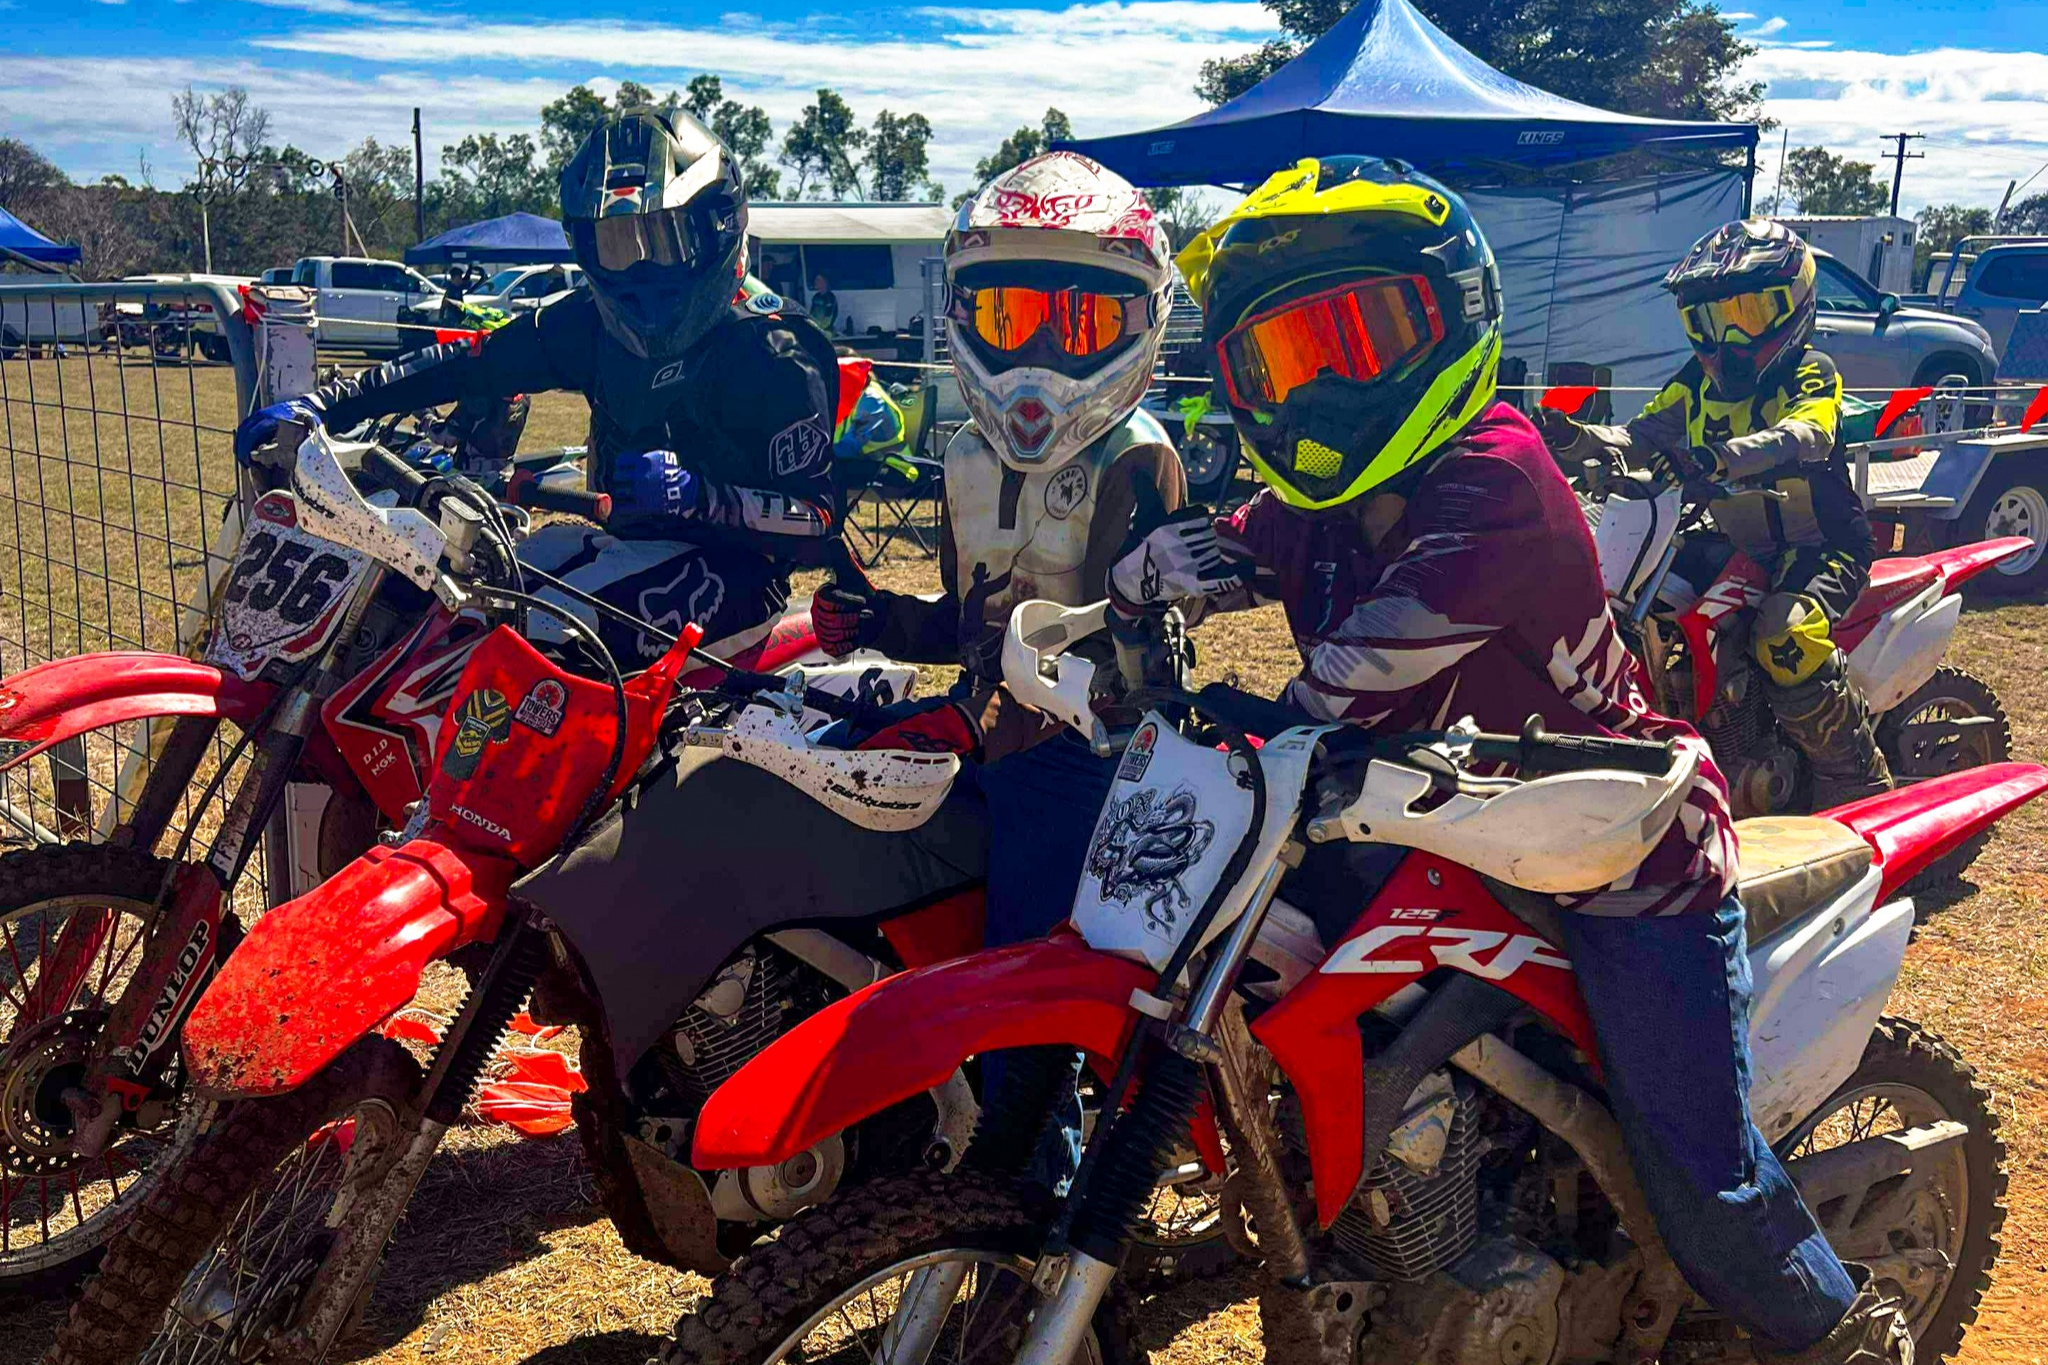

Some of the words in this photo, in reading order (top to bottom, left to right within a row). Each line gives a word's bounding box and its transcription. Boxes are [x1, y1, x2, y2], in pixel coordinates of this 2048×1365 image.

[1517, 131, 1565, 145] KINGS
[225, 531, 350, 625] 256
[519, 696, 561, 725] TOWERS
[371, 751, 396, 776] NGK
[449, 803, 512, 842] HONDA
[1319, 926, 1574, 981] CRF
[124, 918, 210, 1077] DUNLOP
